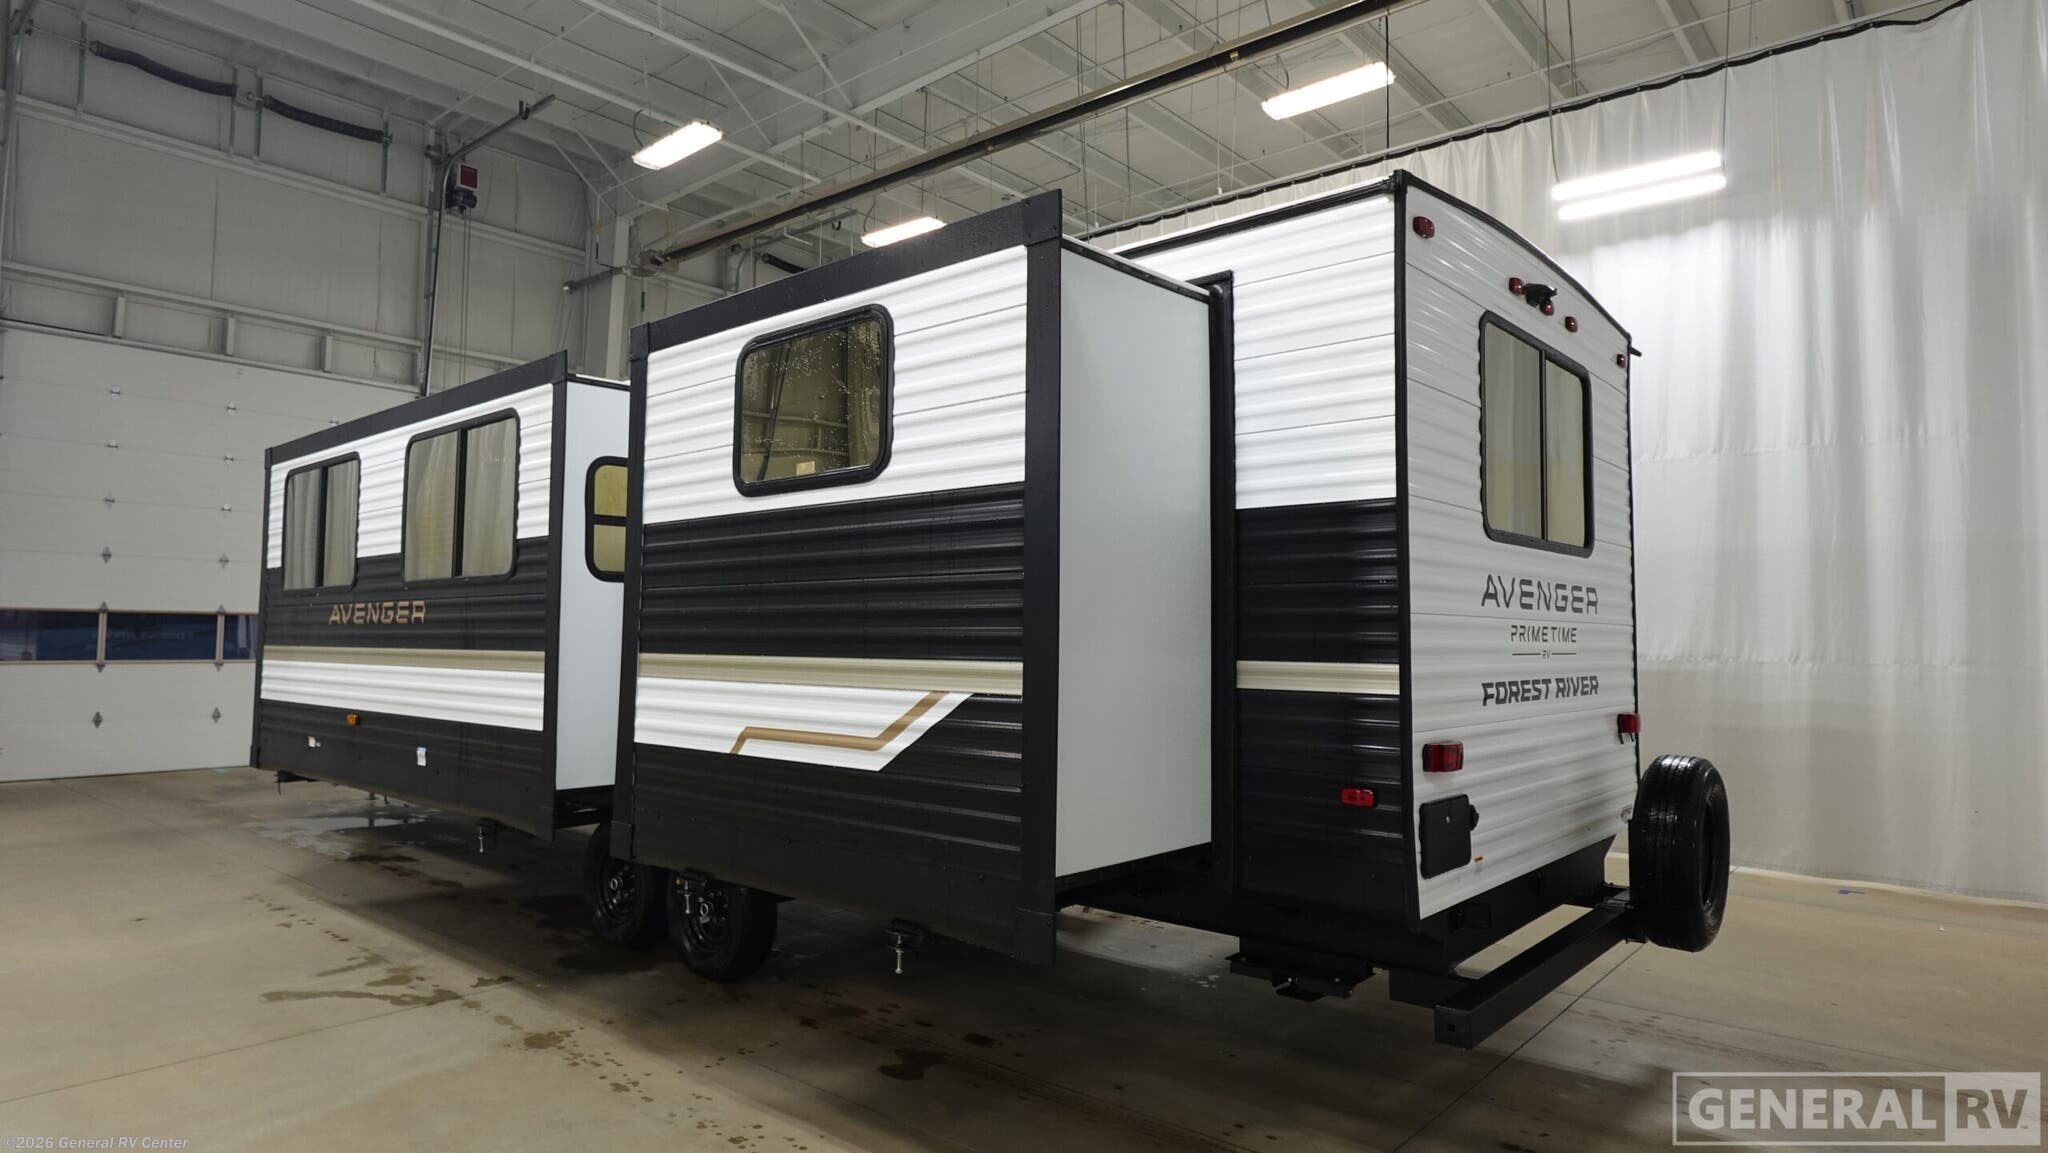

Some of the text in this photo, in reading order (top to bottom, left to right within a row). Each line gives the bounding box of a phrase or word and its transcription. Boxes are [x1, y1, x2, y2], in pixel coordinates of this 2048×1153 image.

[1481, 574, 1599, 614] AVENGER
[328, 600, 426, 625] AVENGER
[1481, 675, 1599, 706] FOREST RIVER
